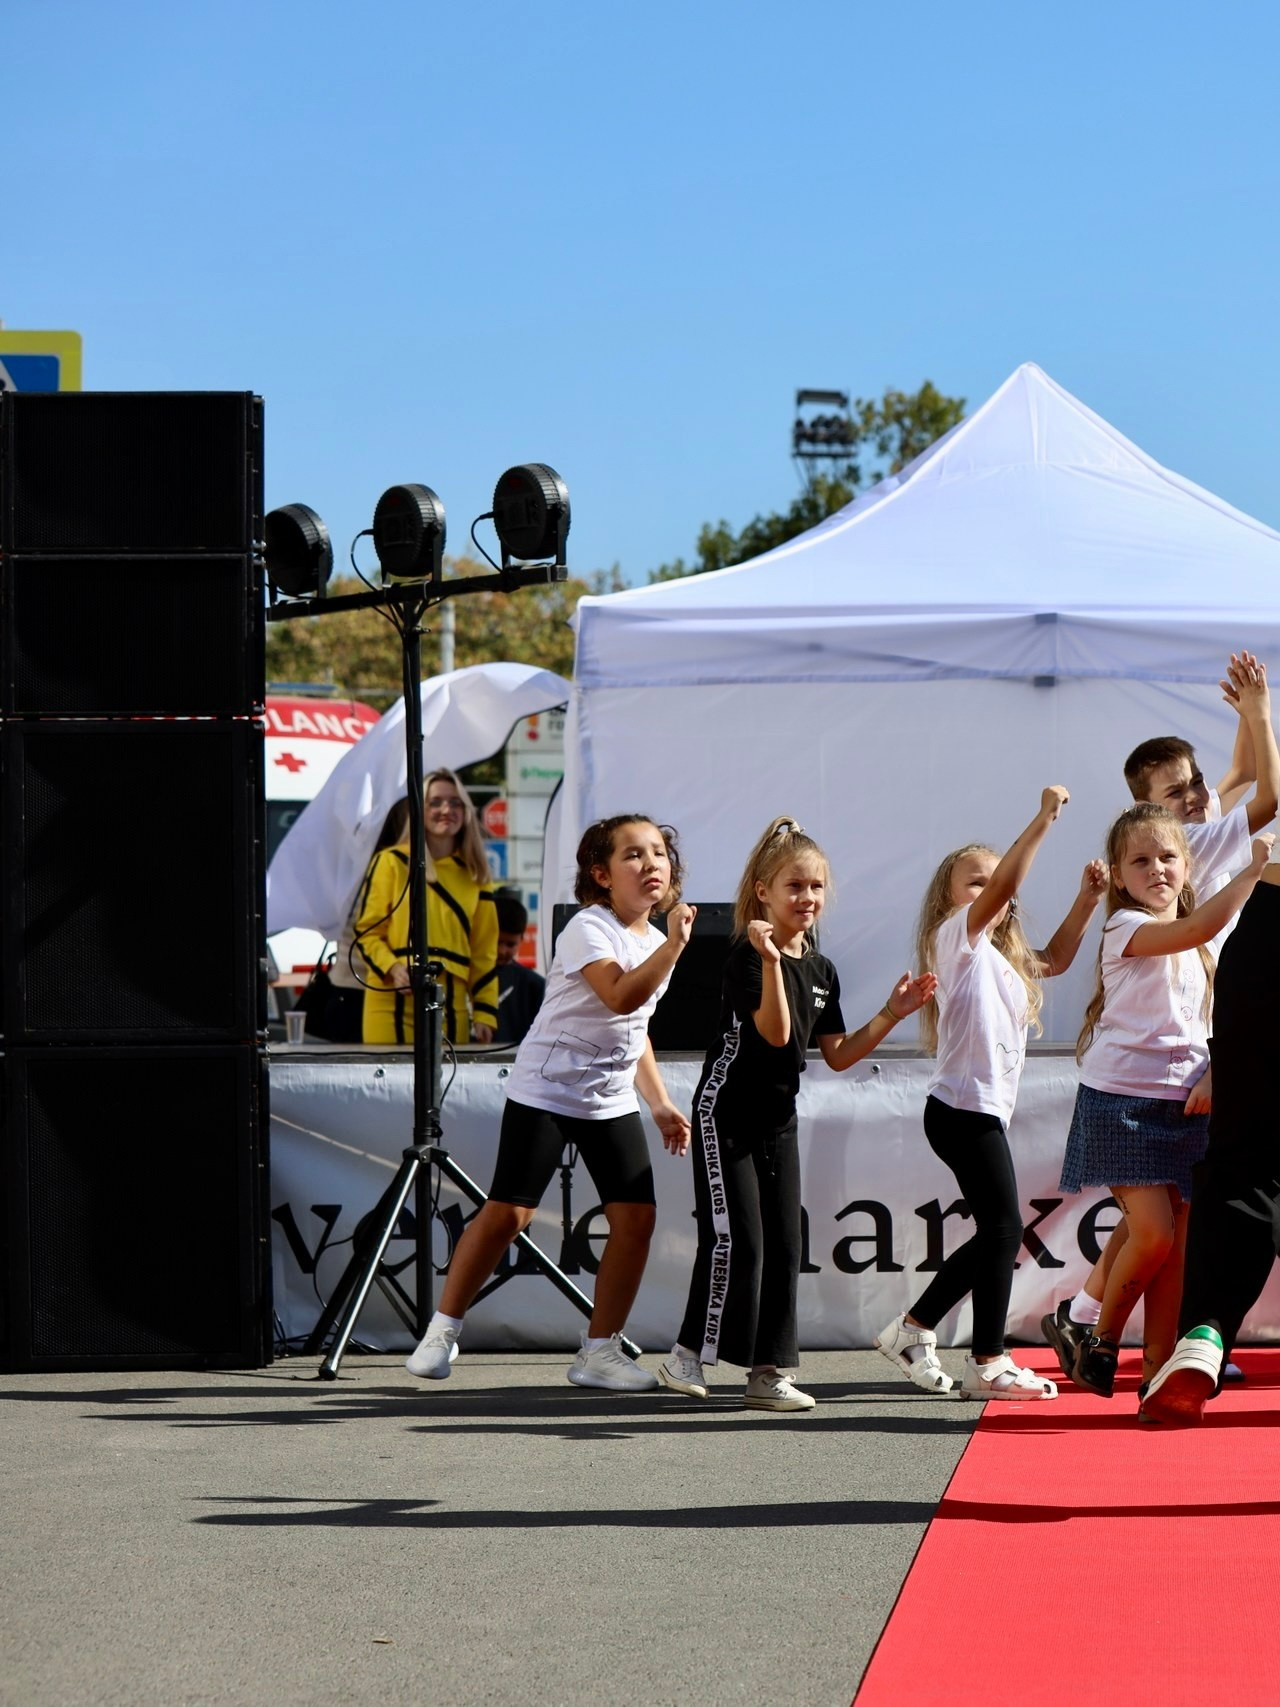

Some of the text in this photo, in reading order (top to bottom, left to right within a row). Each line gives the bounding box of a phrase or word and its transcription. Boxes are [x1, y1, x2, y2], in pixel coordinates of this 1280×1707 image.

[700, 1109, 726, 1215] ATRESHKA KIDS
[705, 1233, 730, 1345] MATRESHKA KIDS
